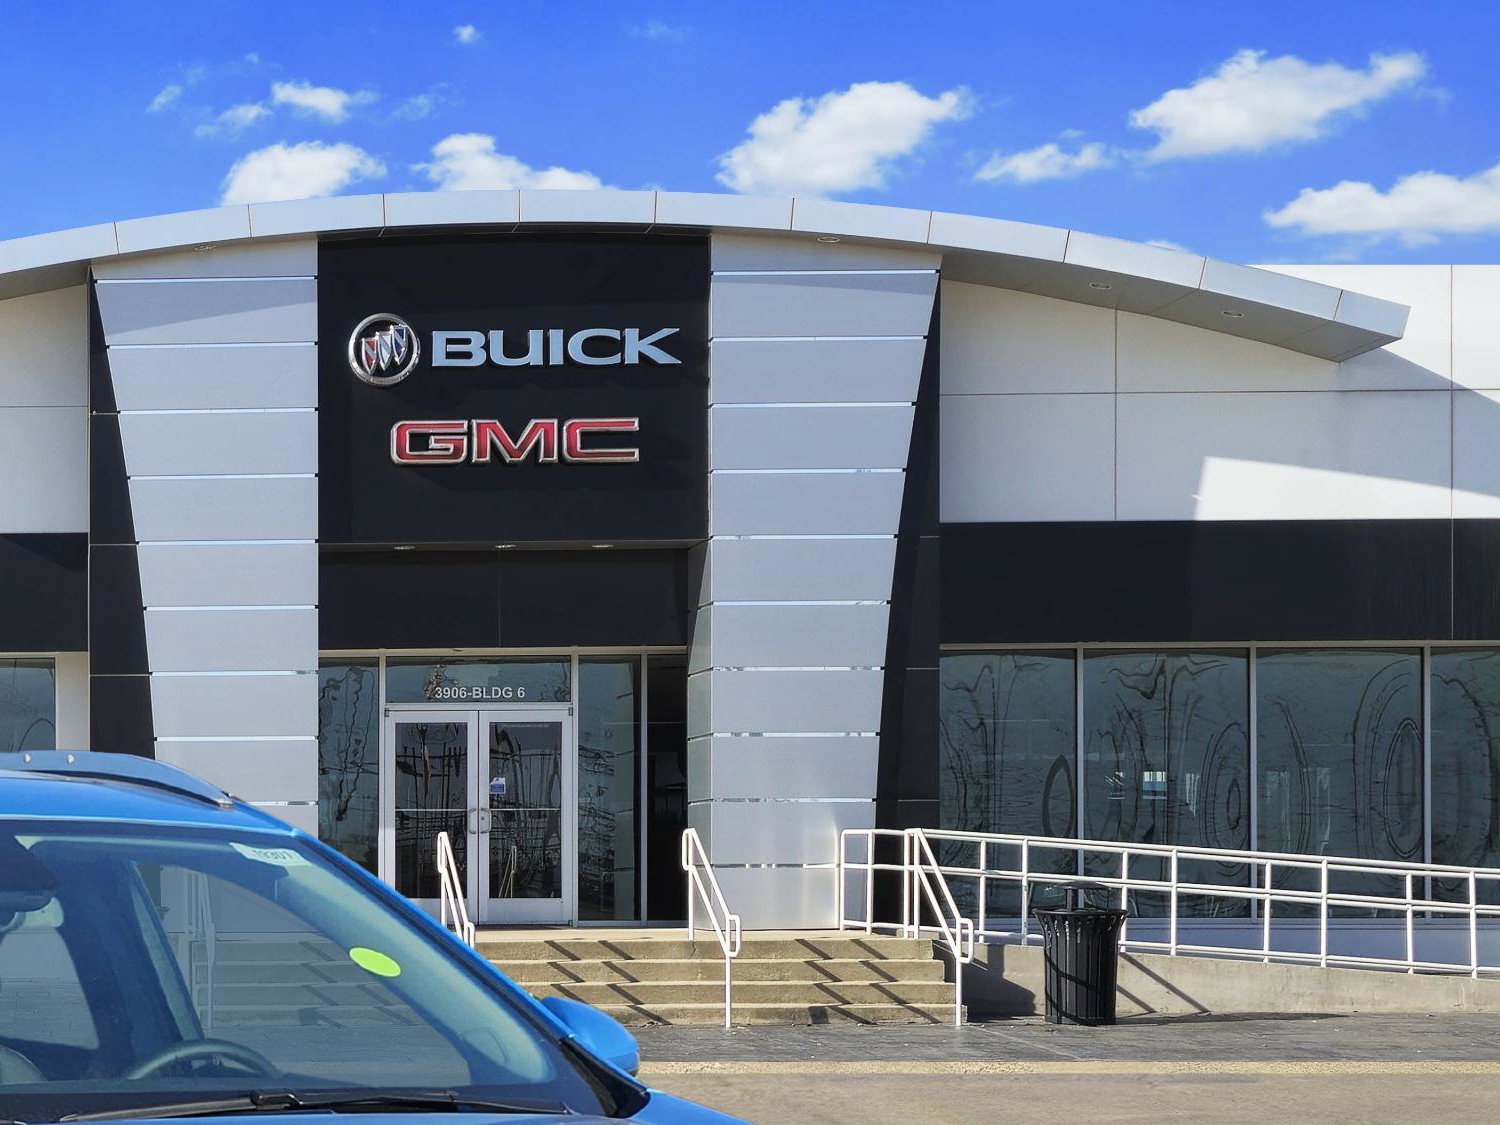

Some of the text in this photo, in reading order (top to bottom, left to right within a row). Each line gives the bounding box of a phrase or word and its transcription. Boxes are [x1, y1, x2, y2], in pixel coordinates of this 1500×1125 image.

[431, 327, 682, 367] BUICK
[390, 417, 640, 464] GMC
[435, 687, 526, 699] 3906-BLDG 6
